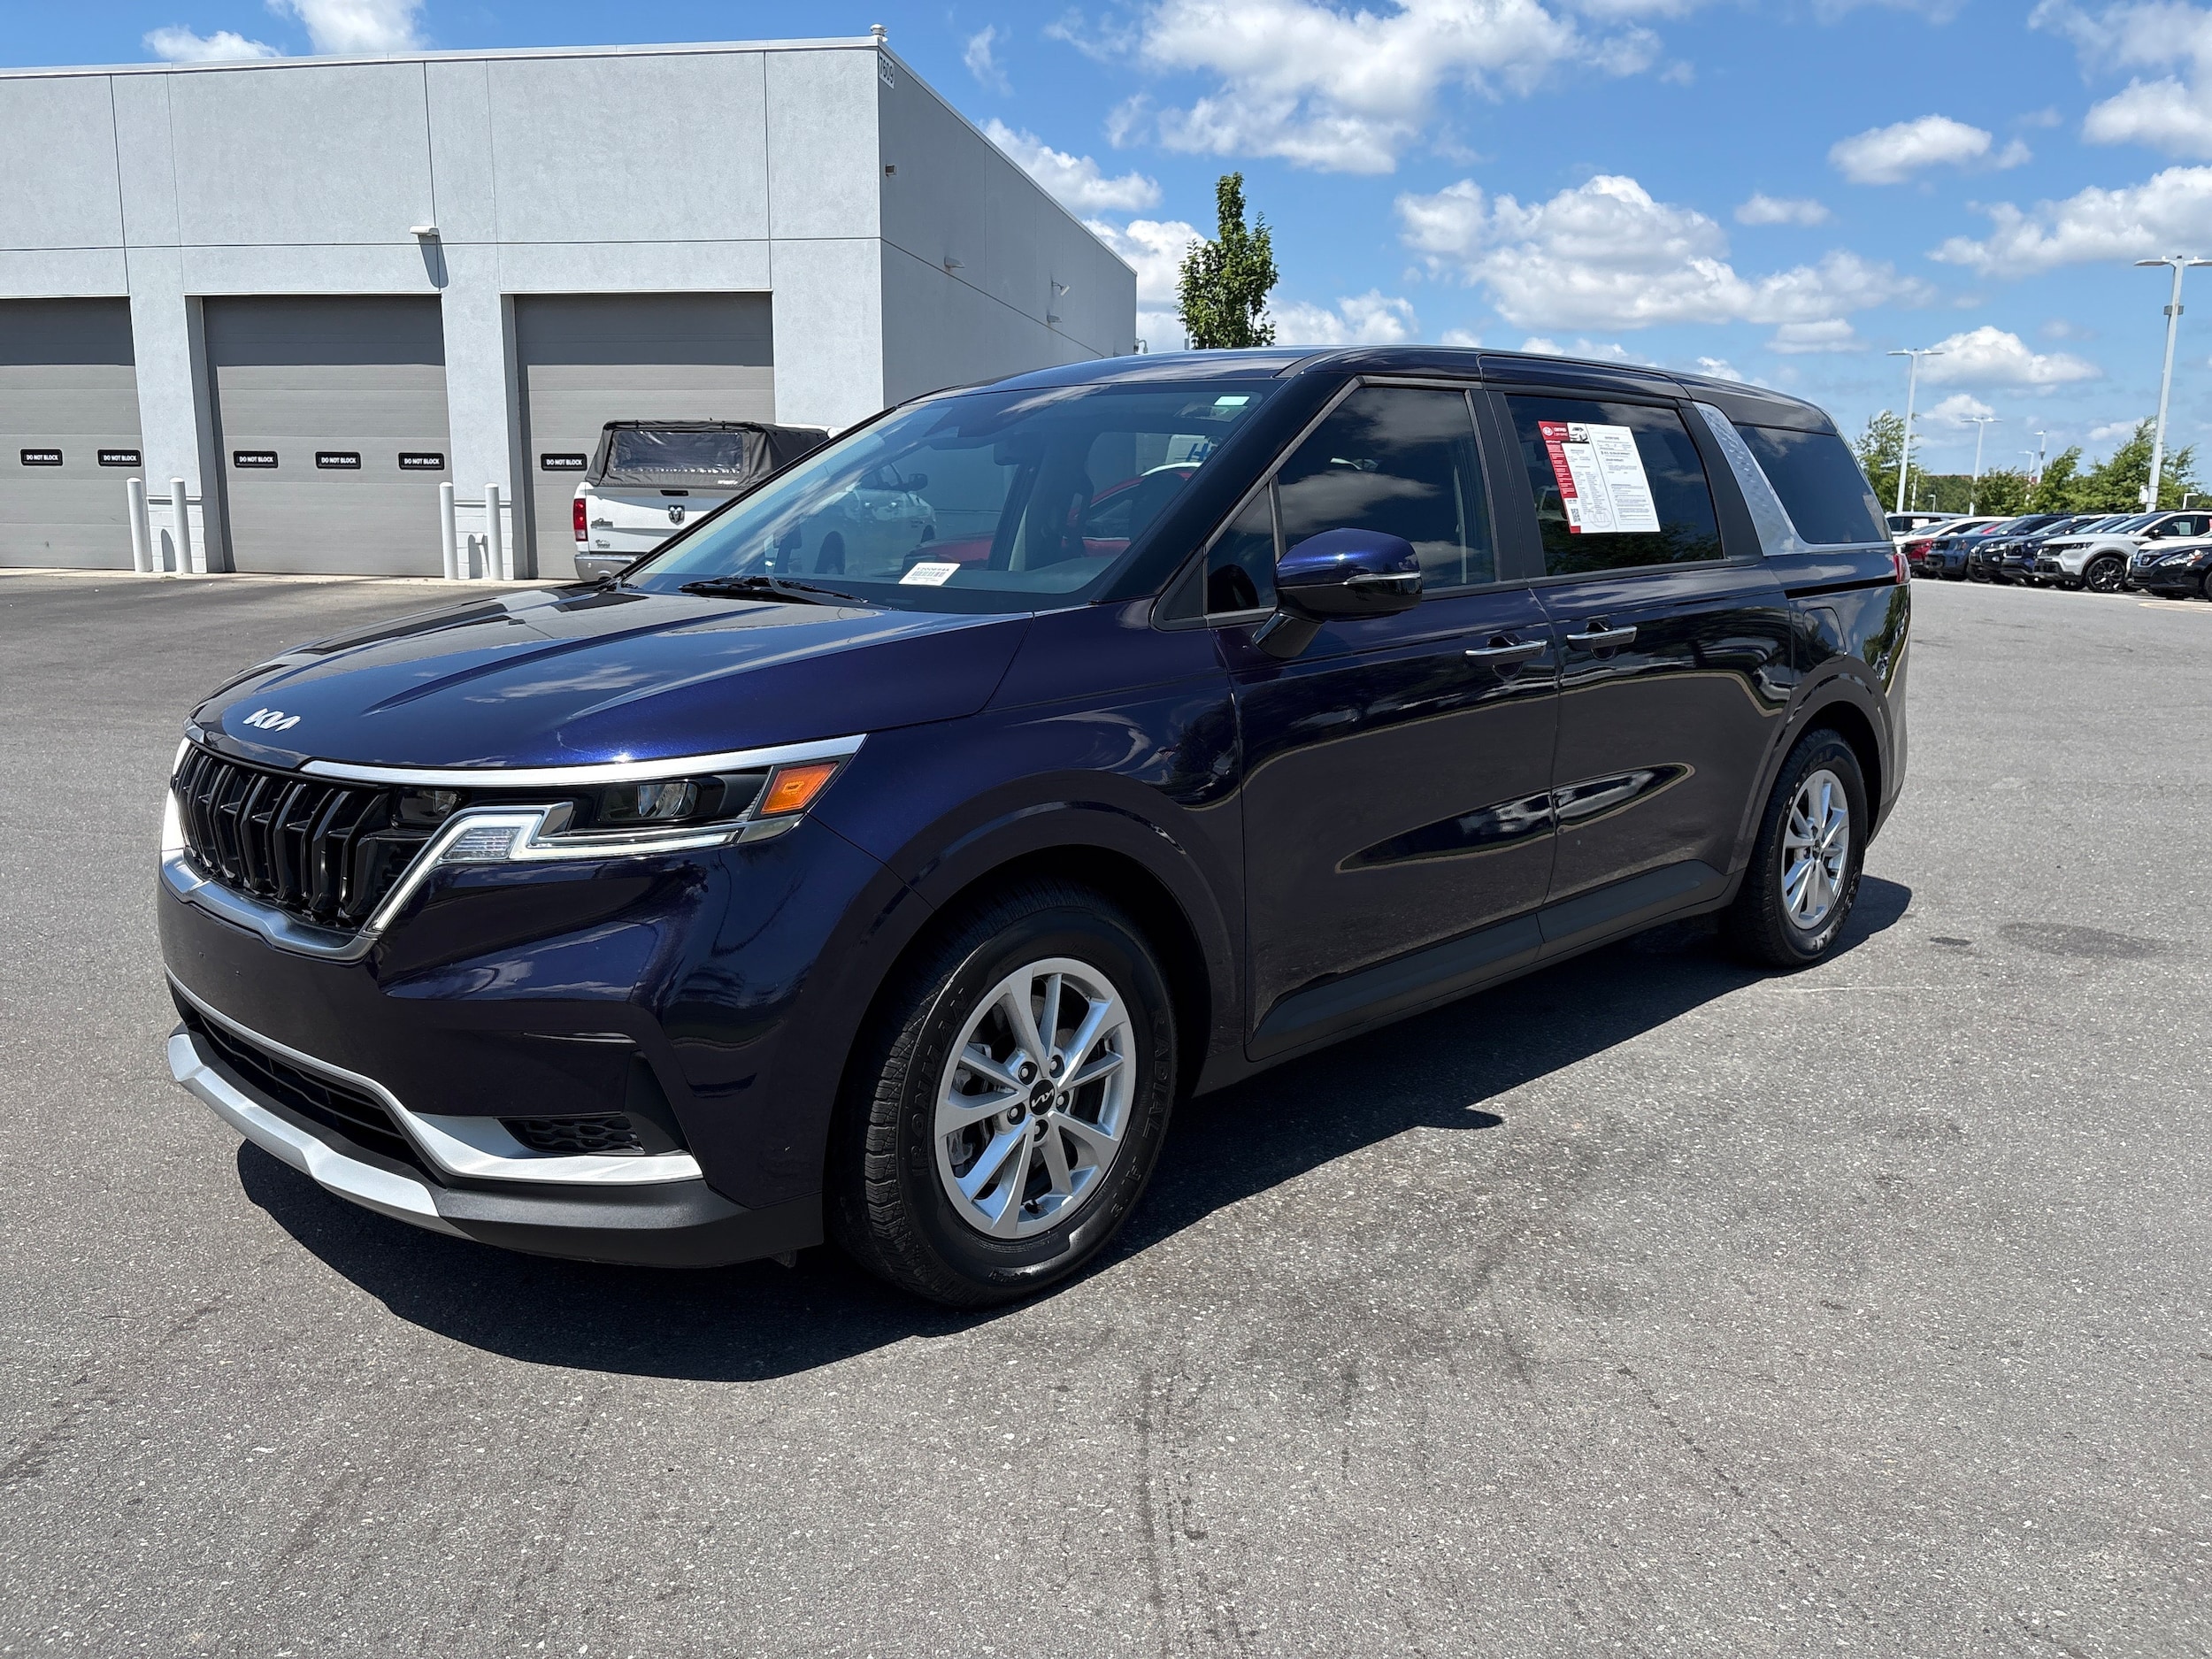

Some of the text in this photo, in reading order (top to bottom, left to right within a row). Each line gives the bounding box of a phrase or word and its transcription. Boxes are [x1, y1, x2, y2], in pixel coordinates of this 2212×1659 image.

[242, 708, 301, 732] KIA
[910, 987, 971, 1178] IRONMAN
[1142, 1005, 1170, 1139] RADIAL
